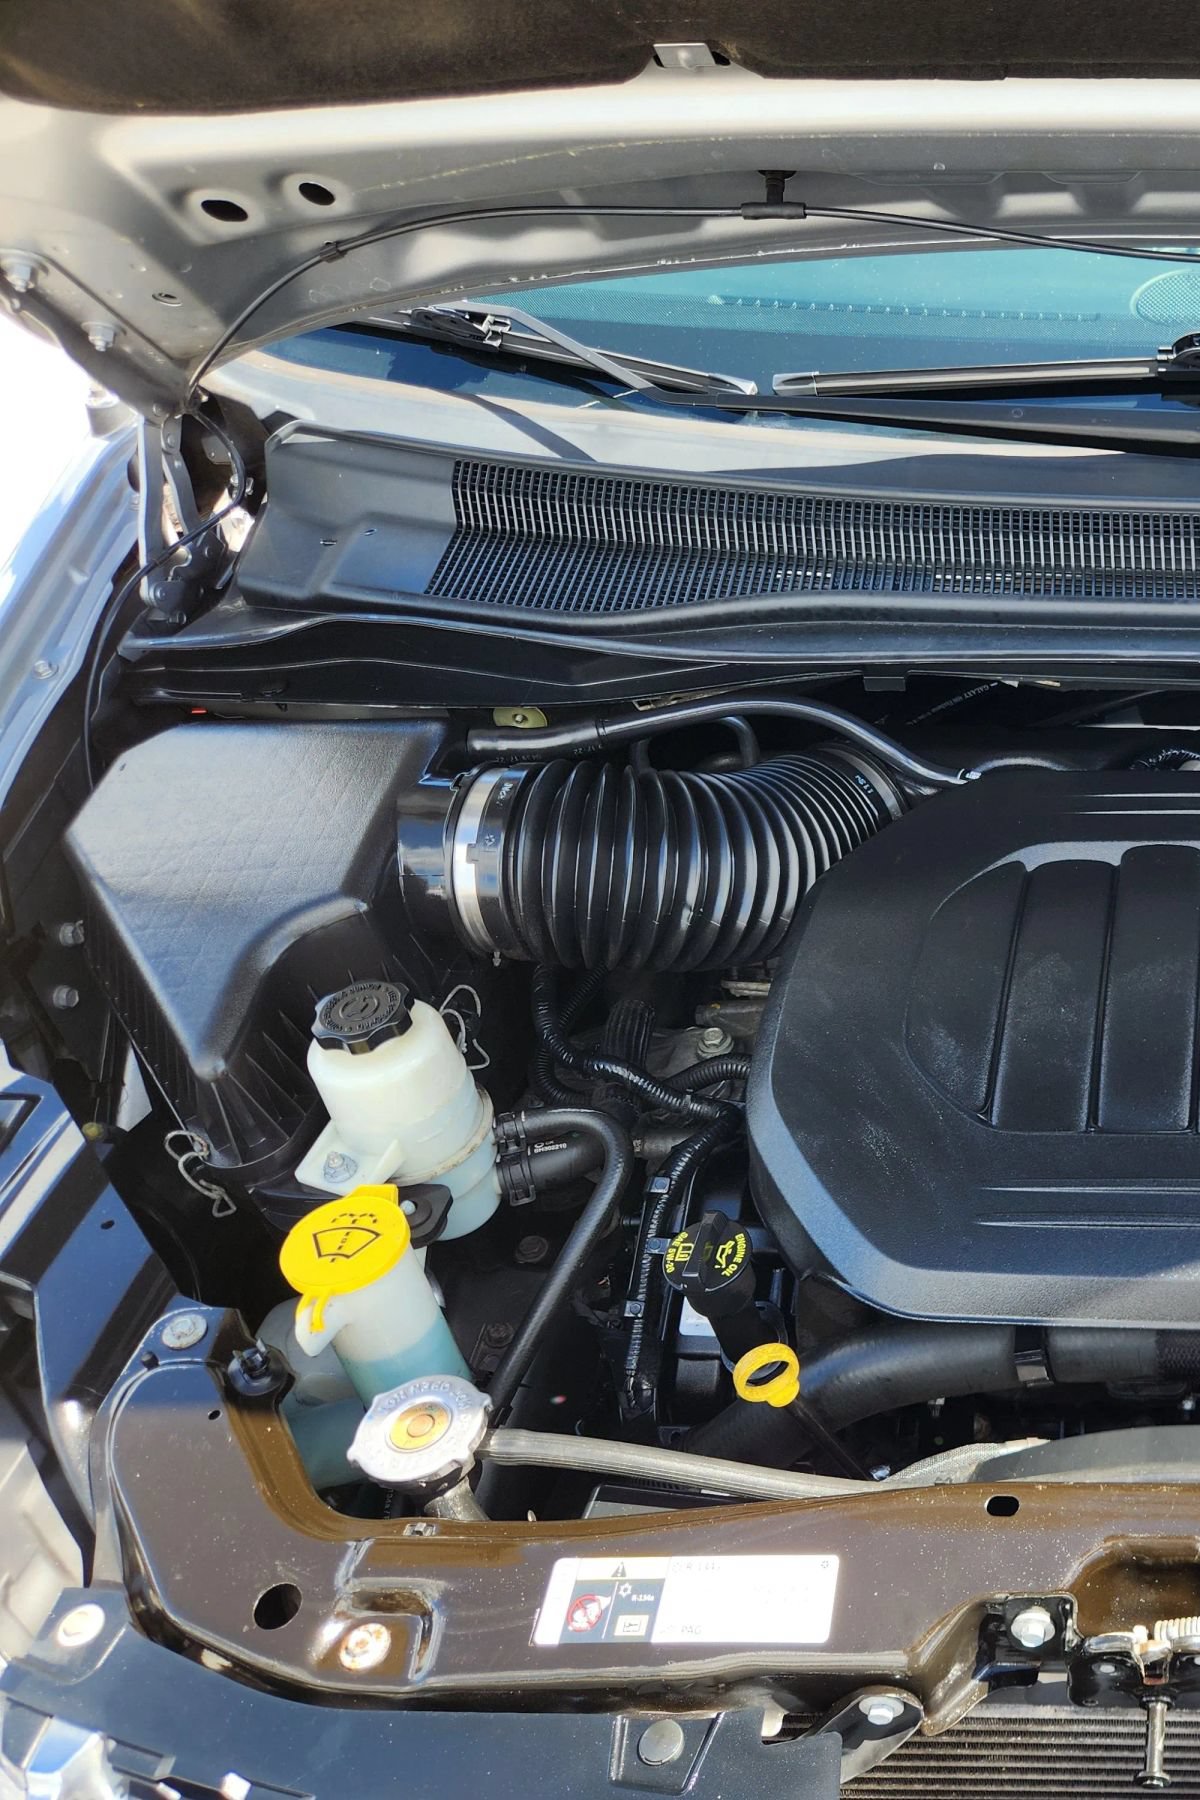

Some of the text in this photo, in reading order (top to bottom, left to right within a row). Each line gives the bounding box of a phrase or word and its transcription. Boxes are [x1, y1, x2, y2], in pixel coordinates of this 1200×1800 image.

[665, 1231, 688, 1273] SAE 5W-20
[721, 1233, 747, 1277] ENGINE OIL
